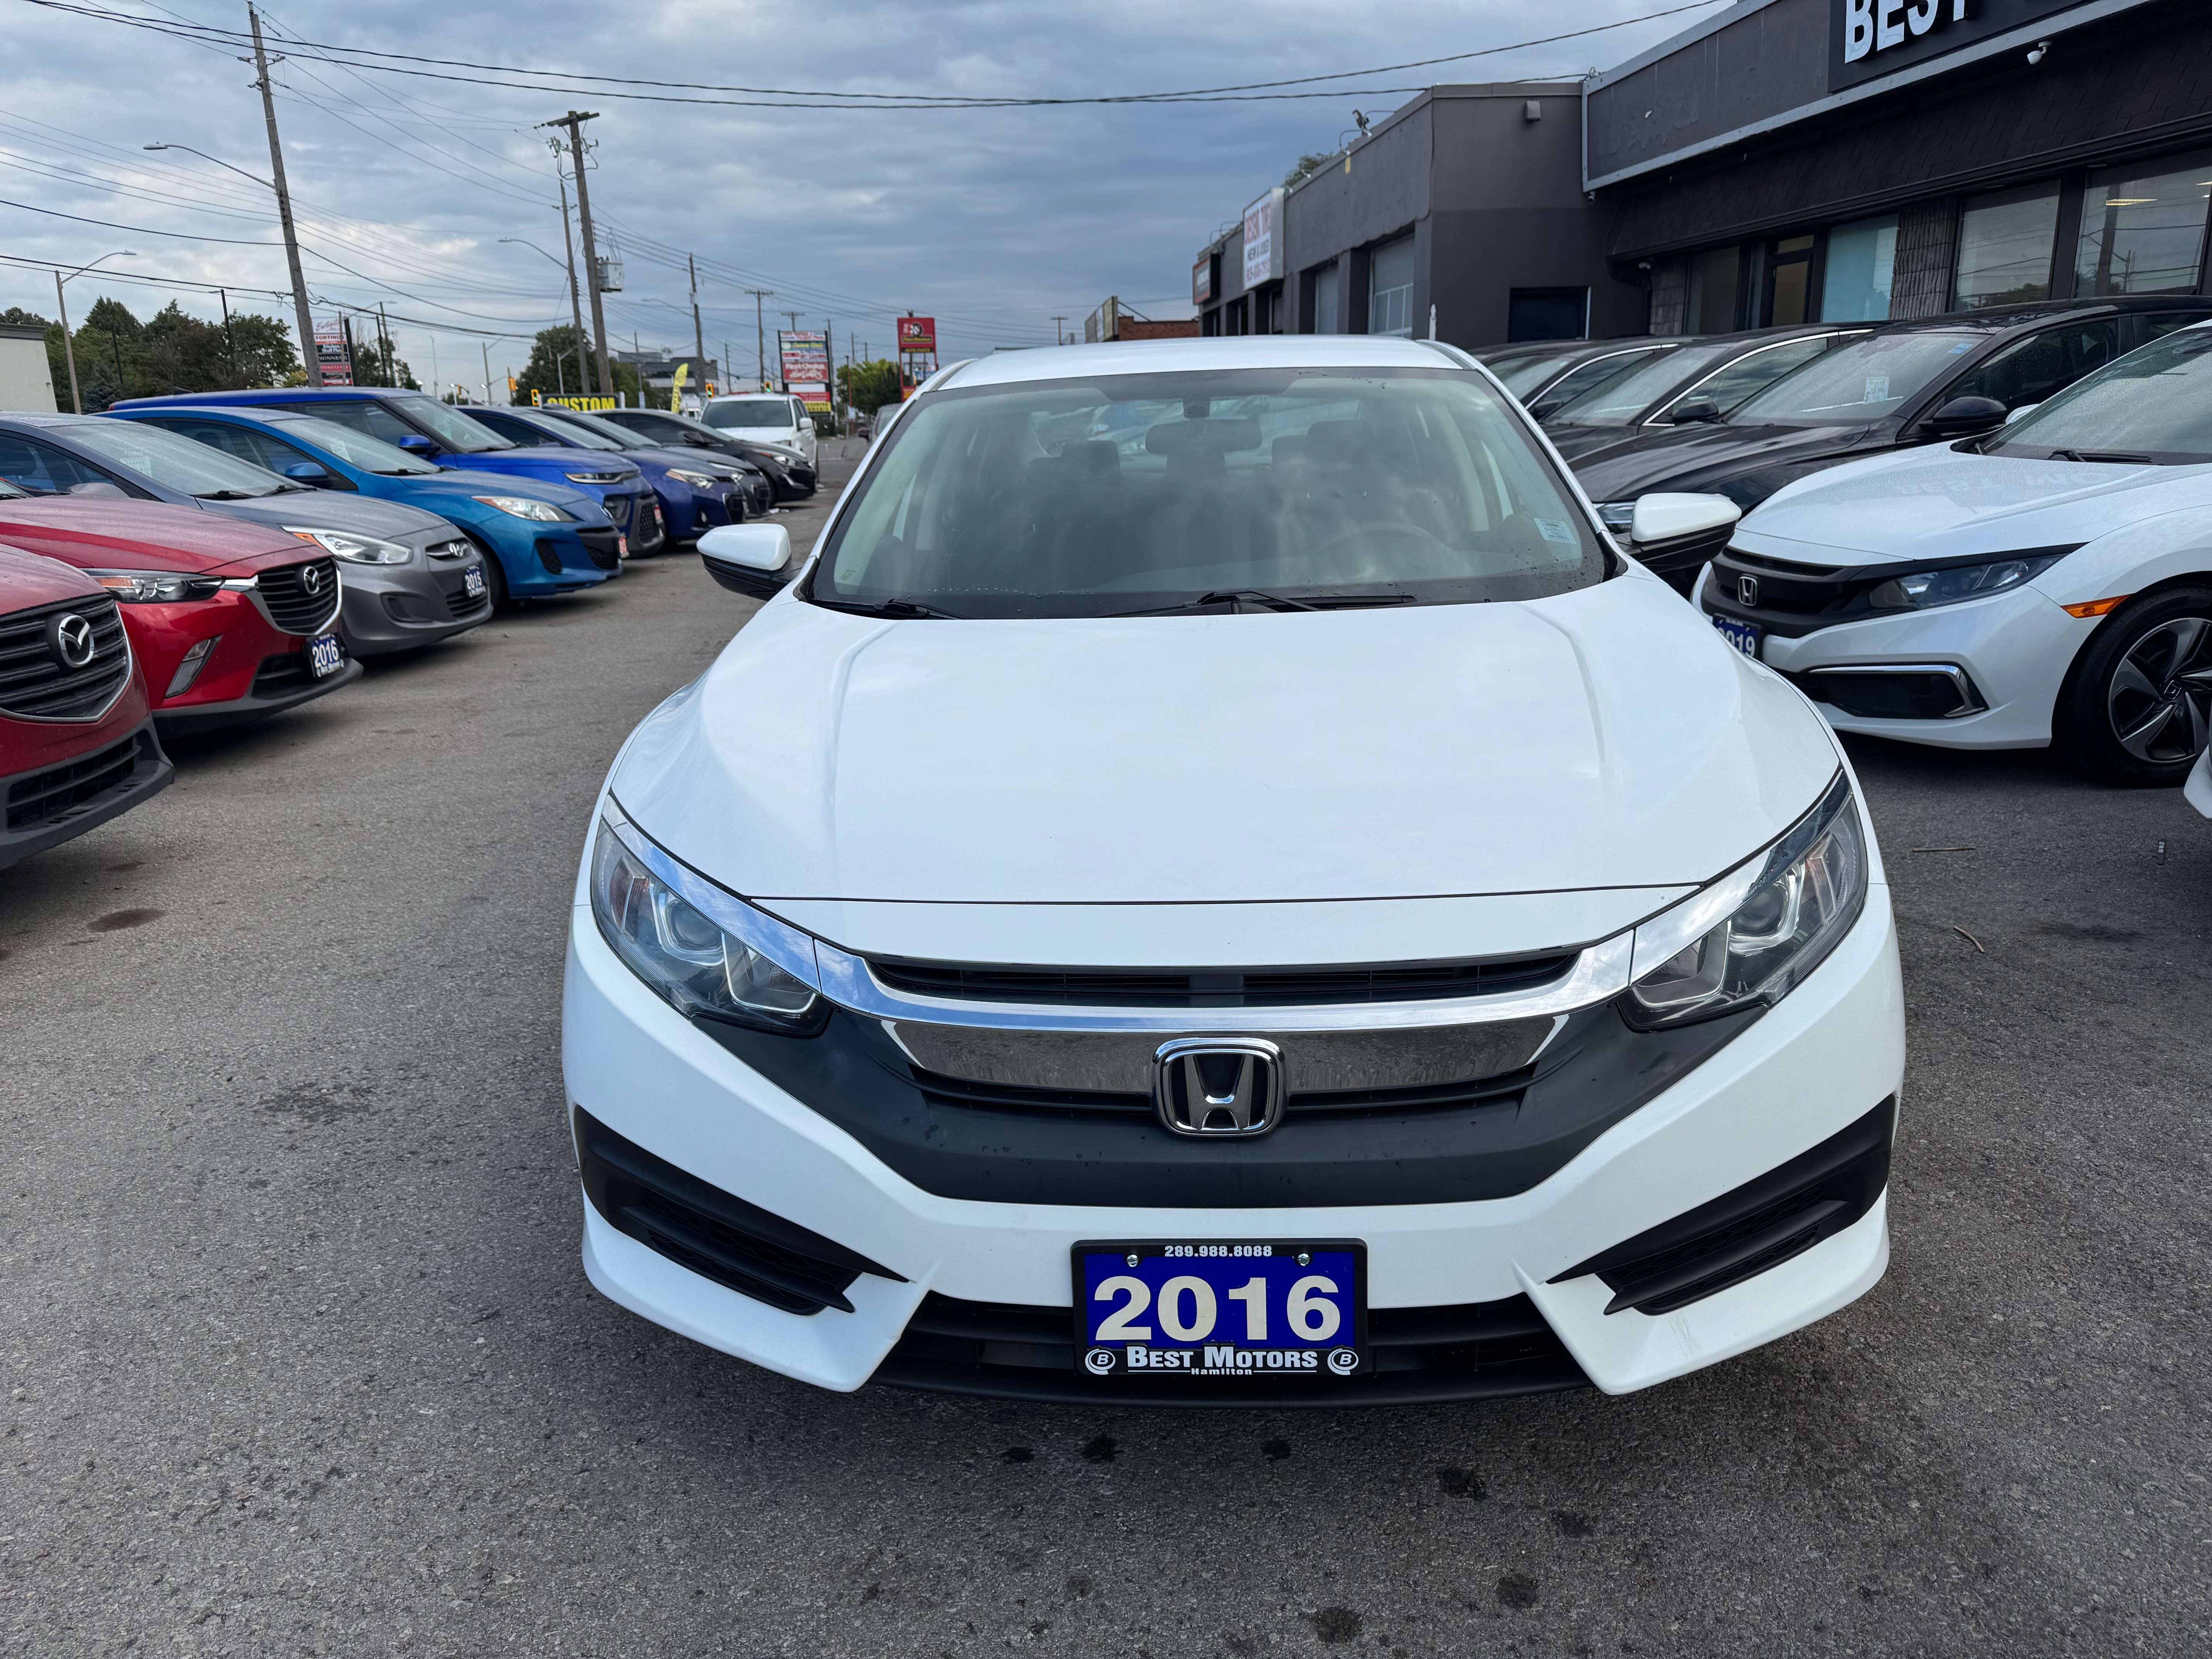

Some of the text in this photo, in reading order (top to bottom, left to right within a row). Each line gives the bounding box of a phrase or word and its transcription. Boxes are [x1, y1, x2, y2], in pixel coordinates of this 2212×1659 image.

[1844, 0, 1965, 64] BE
[465, 571, 482, 590] 2015
[312, 639, 339, 668] 2016
[1164, 1245, 1272, 1257] 289.988.8088
[1094, 1276, 1341, 1341] 2016
[1127, 1346, 1318, 1368] BEST MOTORS
